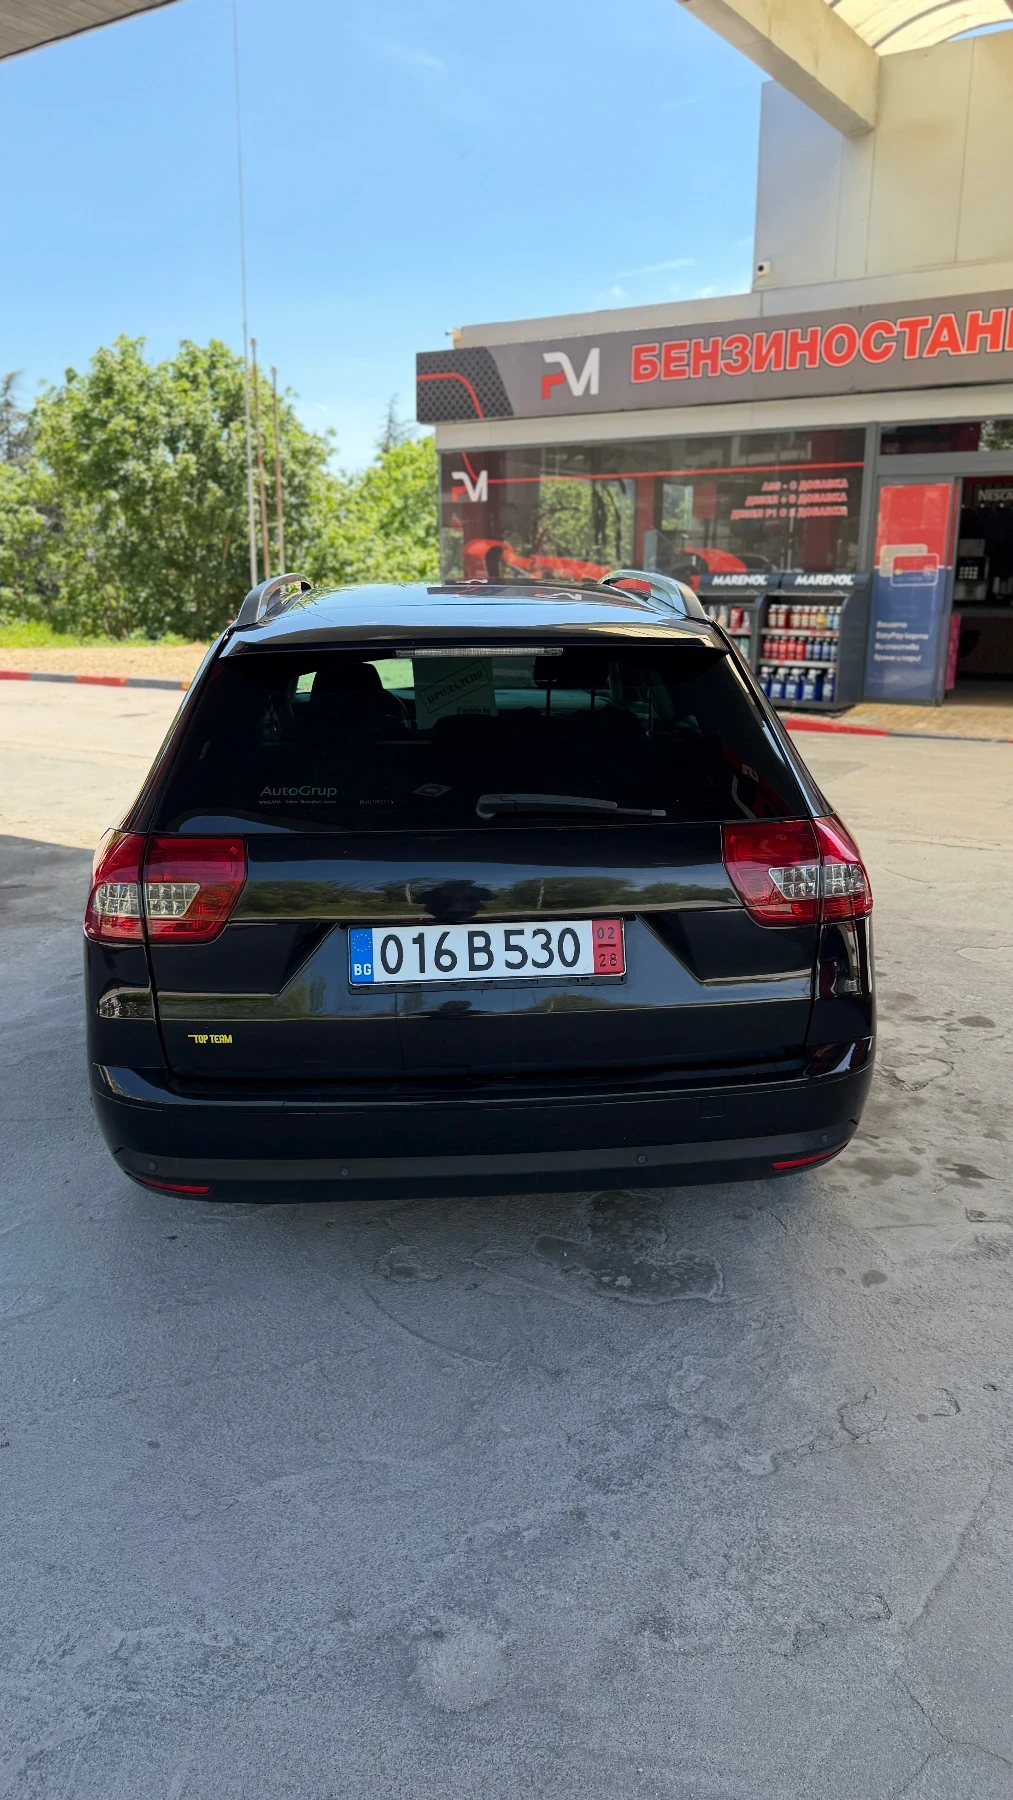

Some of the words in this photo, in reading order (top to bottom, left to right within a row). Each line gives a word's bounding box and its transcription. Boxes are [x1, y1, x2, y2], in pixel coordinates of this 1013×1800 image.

[630, 307, 1013, 383] БЕНЗИНОСТАН
[711, 574, 768, 586] MARENOL
[794, 574, 855, 586] MARENOL
[260, 785, 337, 797] AutoGrup
[596, 926, 615, 940] 02
[598, 953, 618, 967] 28
[354, 963, 372, 976] BG
[188, 1034, 208, 1043] TOP
[209, 1034, 233, 1043] TEAM
